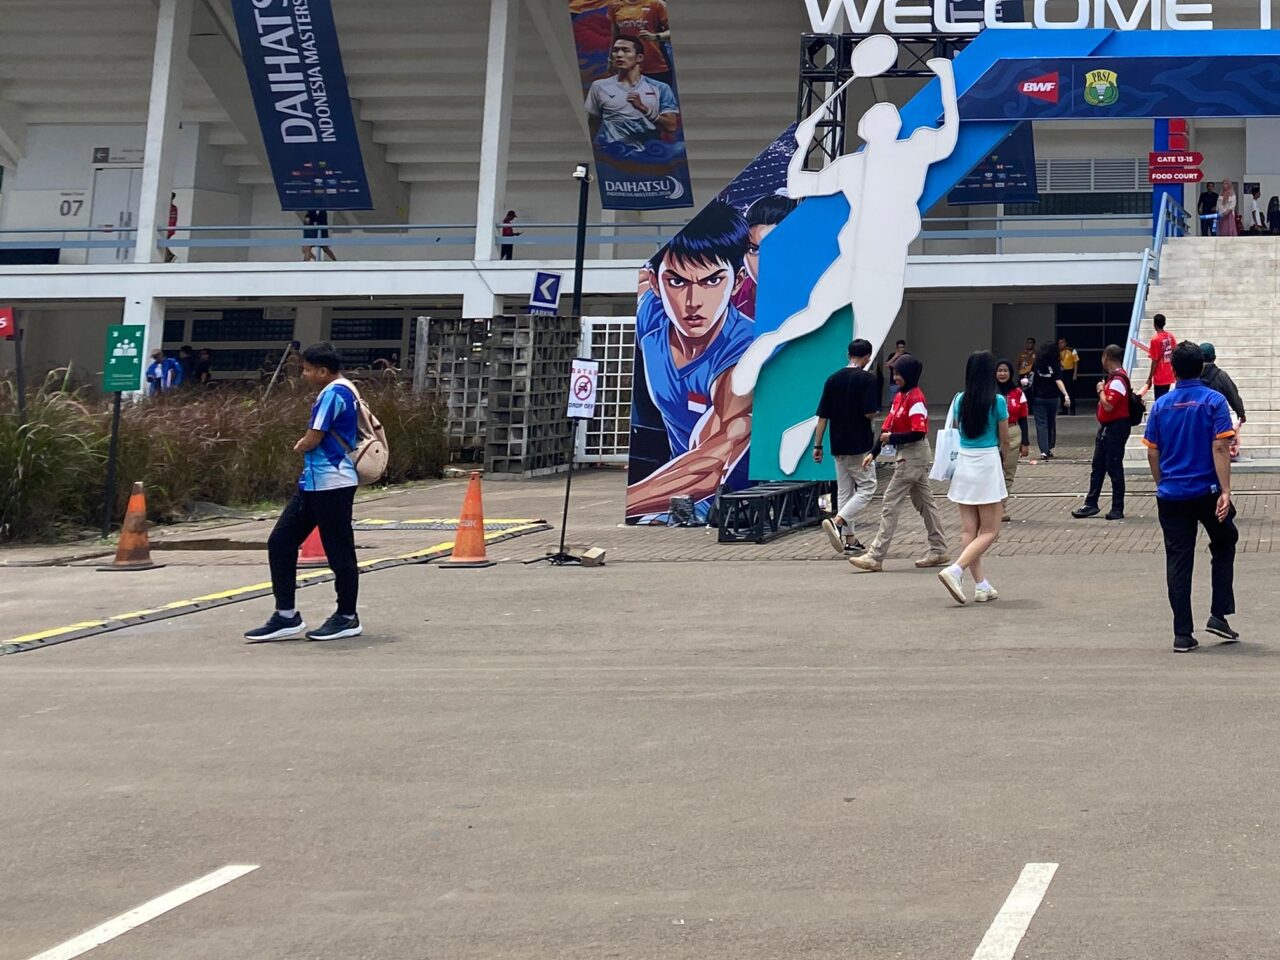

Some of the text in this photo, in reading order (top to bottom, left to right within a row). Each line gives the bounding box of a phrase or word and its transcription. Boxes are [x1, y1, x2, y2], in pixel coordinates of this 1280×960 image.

[1023, 82, 1056, 92] BWF
[309, 66, 337, 142] INDONESIA
[605, 180, 670, 192] DAIHATSU
[60, 200, 84, 216] 07
